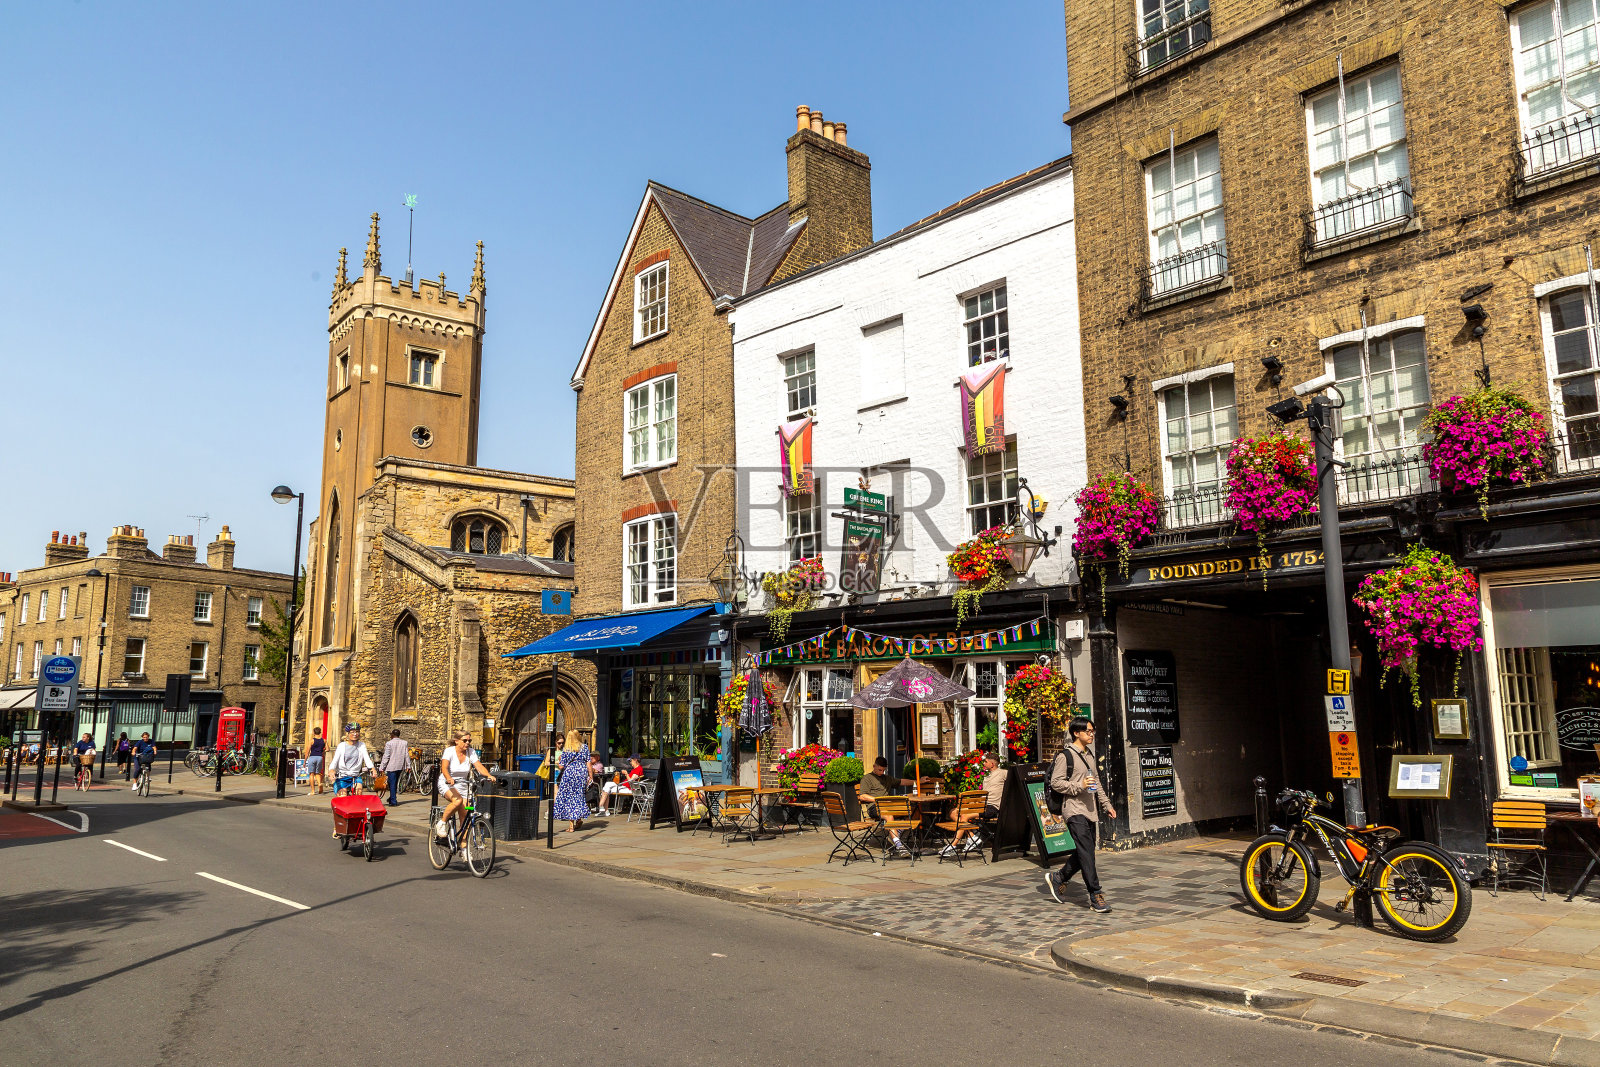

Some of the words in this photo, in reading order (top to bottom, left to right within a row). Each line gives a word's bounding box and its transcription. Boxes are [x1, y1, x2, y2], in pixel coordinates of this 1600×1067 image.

[968, 400, 979, 459] WELCOME
[994, 414, 1005, 451] EVERY
[870, 497, 884, 506] KING
[1148, 558, 1244, 581] FOUNDED
[1248, 554, 1273, 571] IN
[799, 640, 831, 660] THE
[837, 636, 904, 658] BARON
[912, 633, 938, 653] OF
[947, 629, 998, 652] BEEF
[1131, 666, 1149, 676] BARON
[1154, 667, 1168, 677] BEEF
[1131, 718, 1160, 731] Courtyard
[1560, 722, 1600, 735] NICHOLS
[1141, 757, 1157, 766] Curry
[1159, 756, 1172, 766] King
